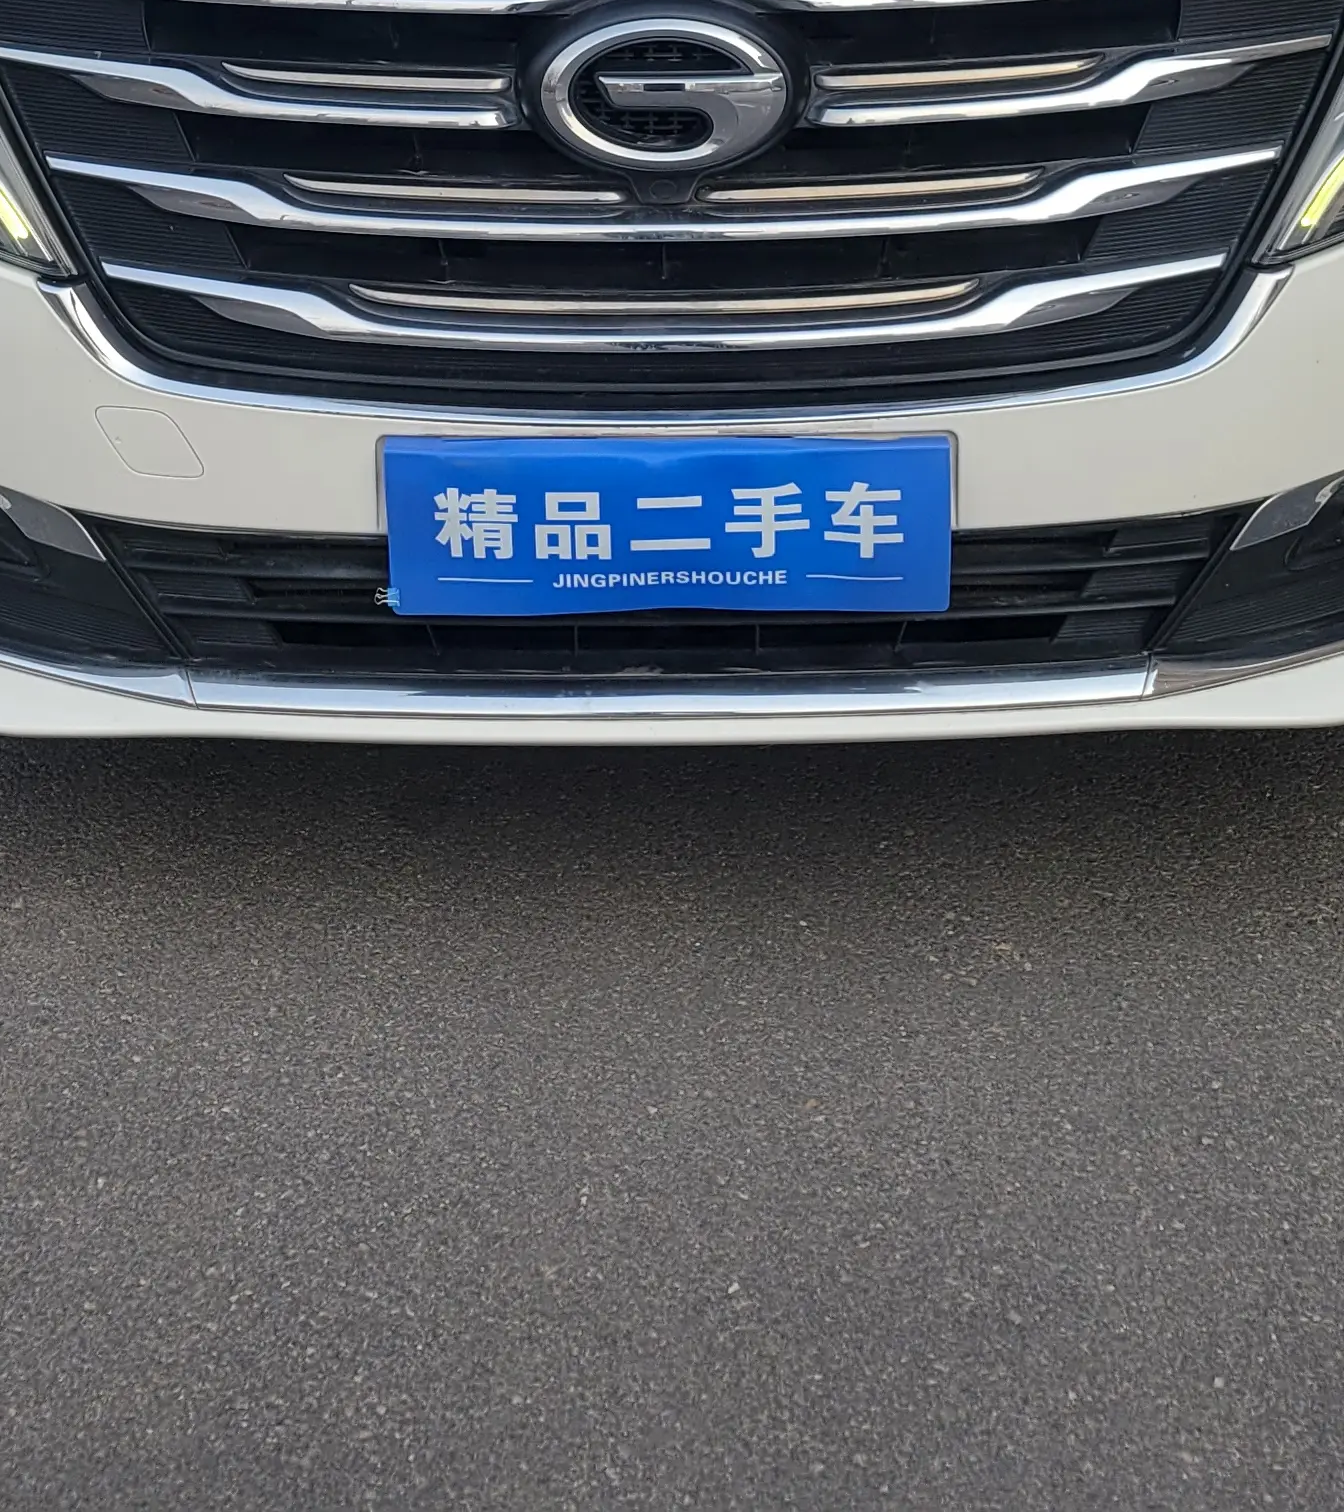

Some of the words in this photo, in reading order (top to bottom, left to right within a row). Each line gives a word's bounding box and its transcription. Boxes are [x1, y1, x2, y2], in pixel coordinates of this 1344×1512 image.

[433, 481, 905, 560] 精品二手车
[553, 569, 788, 588] JINGPINERSHOUCHE
